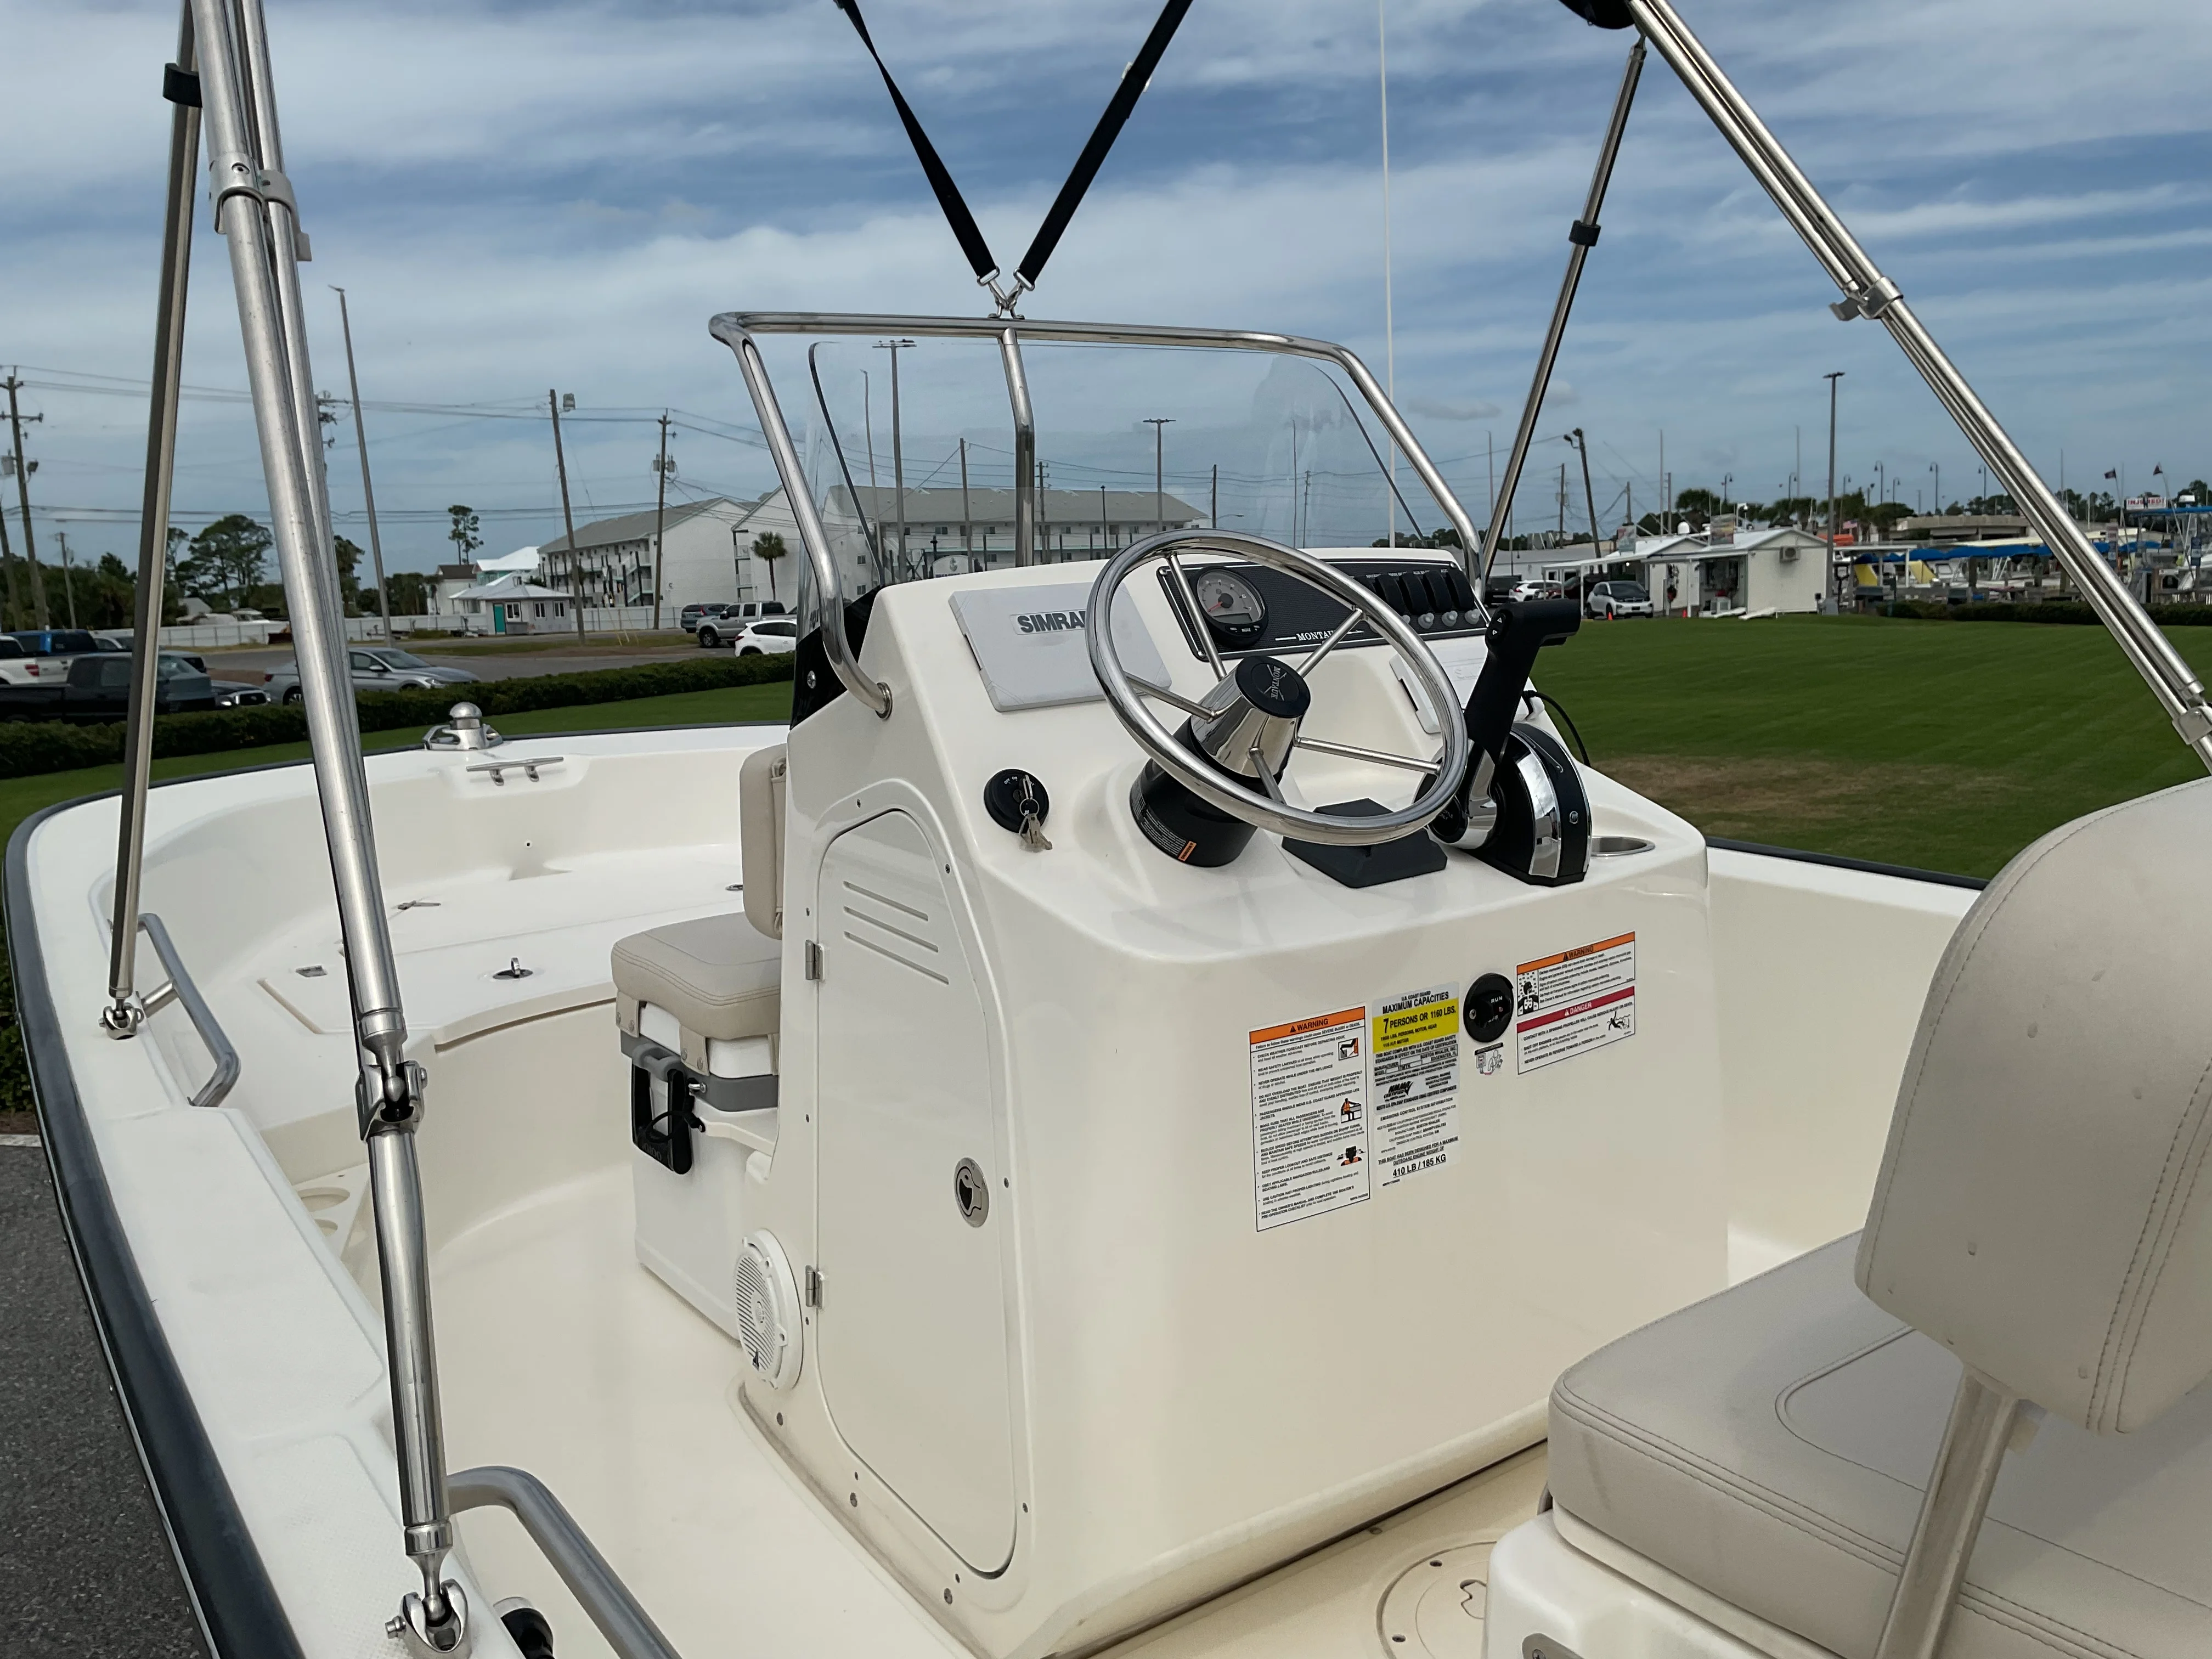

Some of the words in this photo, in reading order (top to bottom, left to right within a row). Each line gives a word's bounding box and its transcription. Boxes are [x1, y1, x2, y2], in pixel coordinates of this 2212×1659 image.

[1271, 665, 1281, 700] MONTAUK
[1568, 946, 1593, 958] WARNING
[1383, 1000, 1412, 1013] MAXIMUM
[1414, 992, 1449, 1006] CAPACITIES
[1570, 1002, 1592, 1014] DANGER
[1297, 1018, 1328, 1031] WARNING
[1383, 1018, 1389, 1033] 7
[1390, 1014, 1418, 1028] PERSONS
[1419, 1012, 1428, 1021] OR
[1430, 1009, 1442, 1018] 1160
[1443, 1006, 1456, 1015] LBS.
[1414, 1144, 1431, 1153] DESIGNED
[1392, 1166, 1405, 1177] 410
[1407, 1163, 1416, 1172] LB
[1422, 1158, 1434, 1167] 185
[1436, 1154, 1446, 1164] KG
